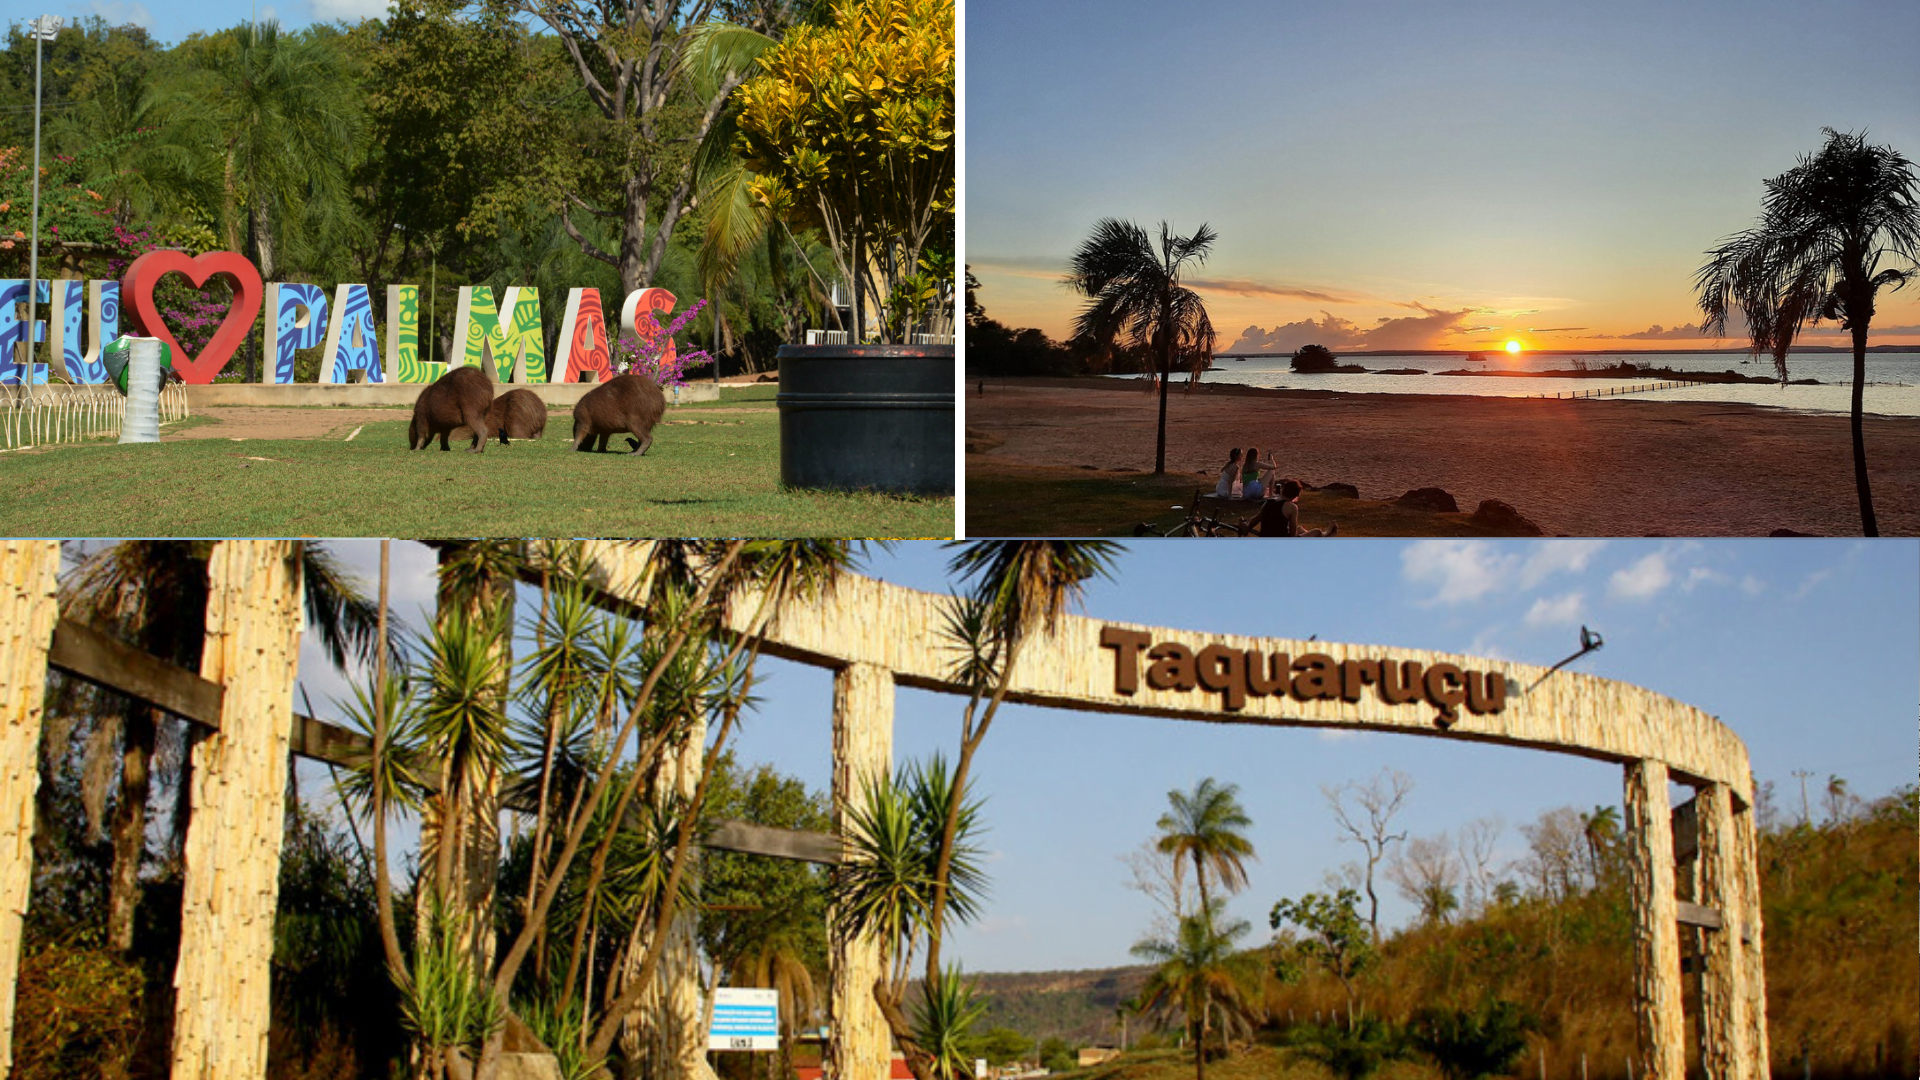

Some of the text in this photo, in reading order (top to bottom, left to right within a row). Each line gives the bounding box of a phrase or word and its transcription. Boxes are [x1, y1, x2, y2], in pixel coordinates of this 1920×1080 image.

[0, 279, 677, 384] EU PALMAS
[1100, 626, 1505, 729] Taquaruçu
